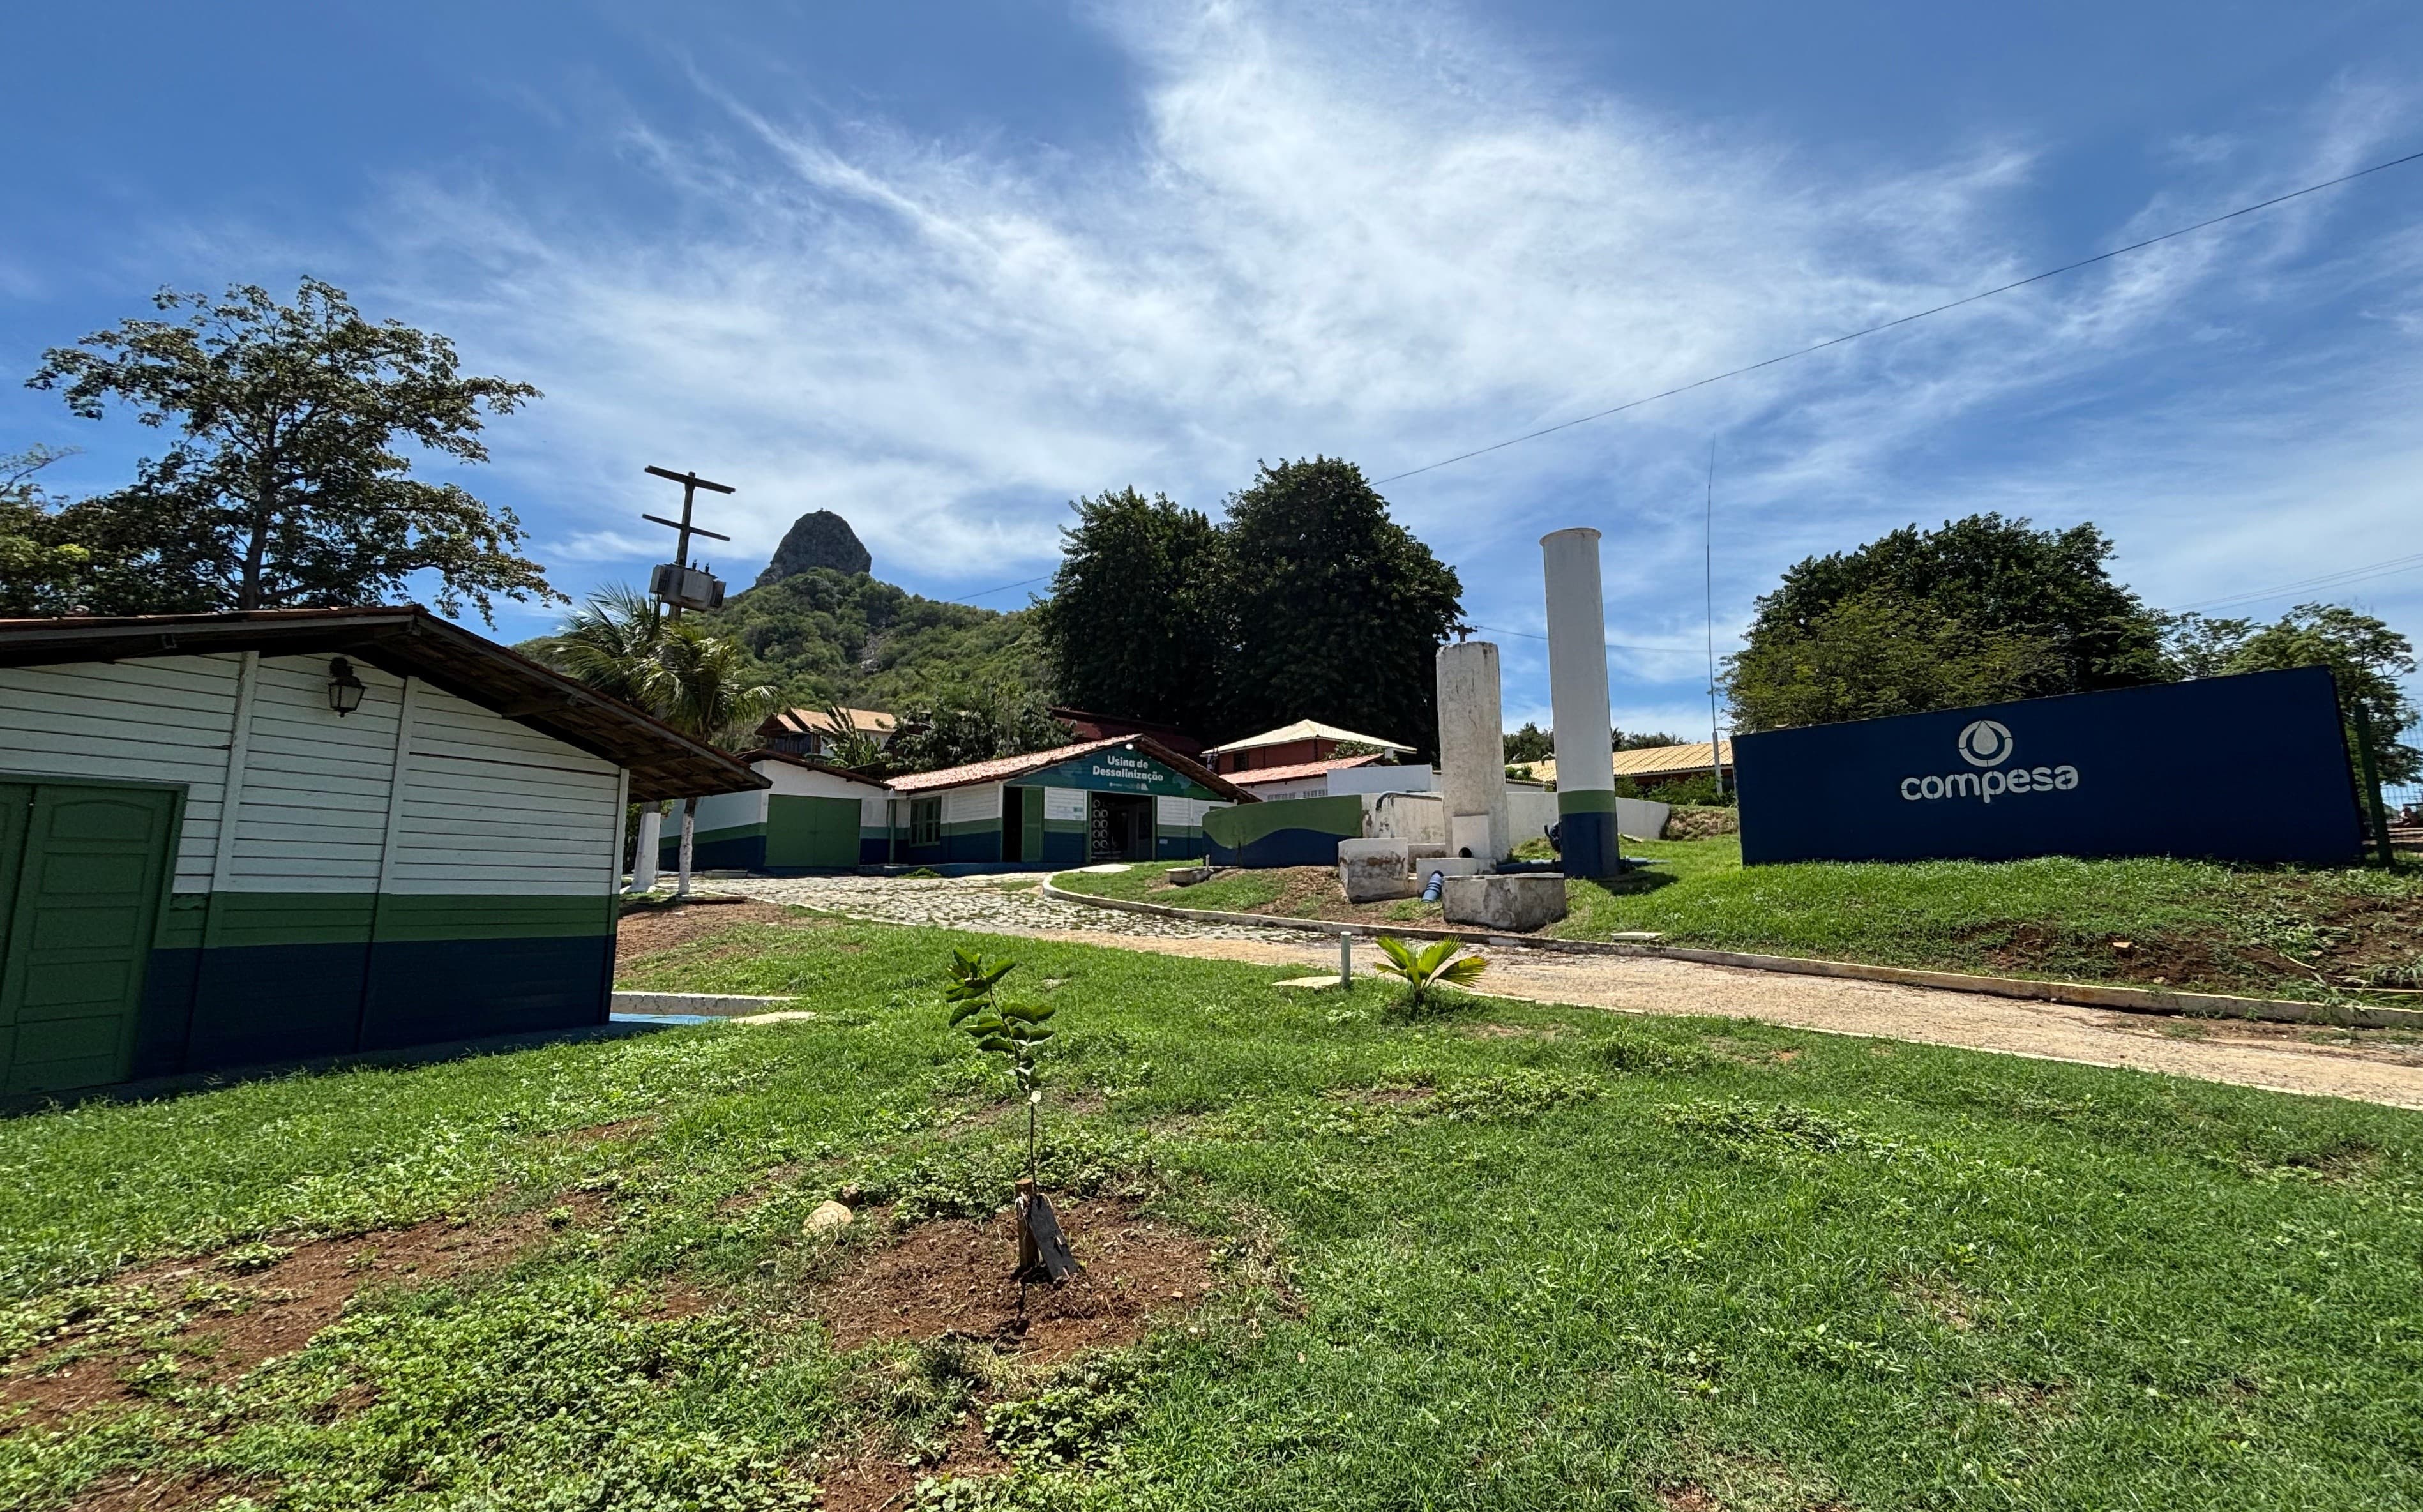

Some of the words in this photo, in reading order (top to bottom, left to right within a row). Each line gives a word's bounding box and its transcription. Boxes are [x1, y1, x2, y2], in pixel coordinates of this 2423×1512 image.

[1107, 755, 1135, 767] Usina
[1136, 759, 1149, 769] de
[1092, 765, 1163, 783] Dessalinização
[1901, 765, 2079, 804] compesa
